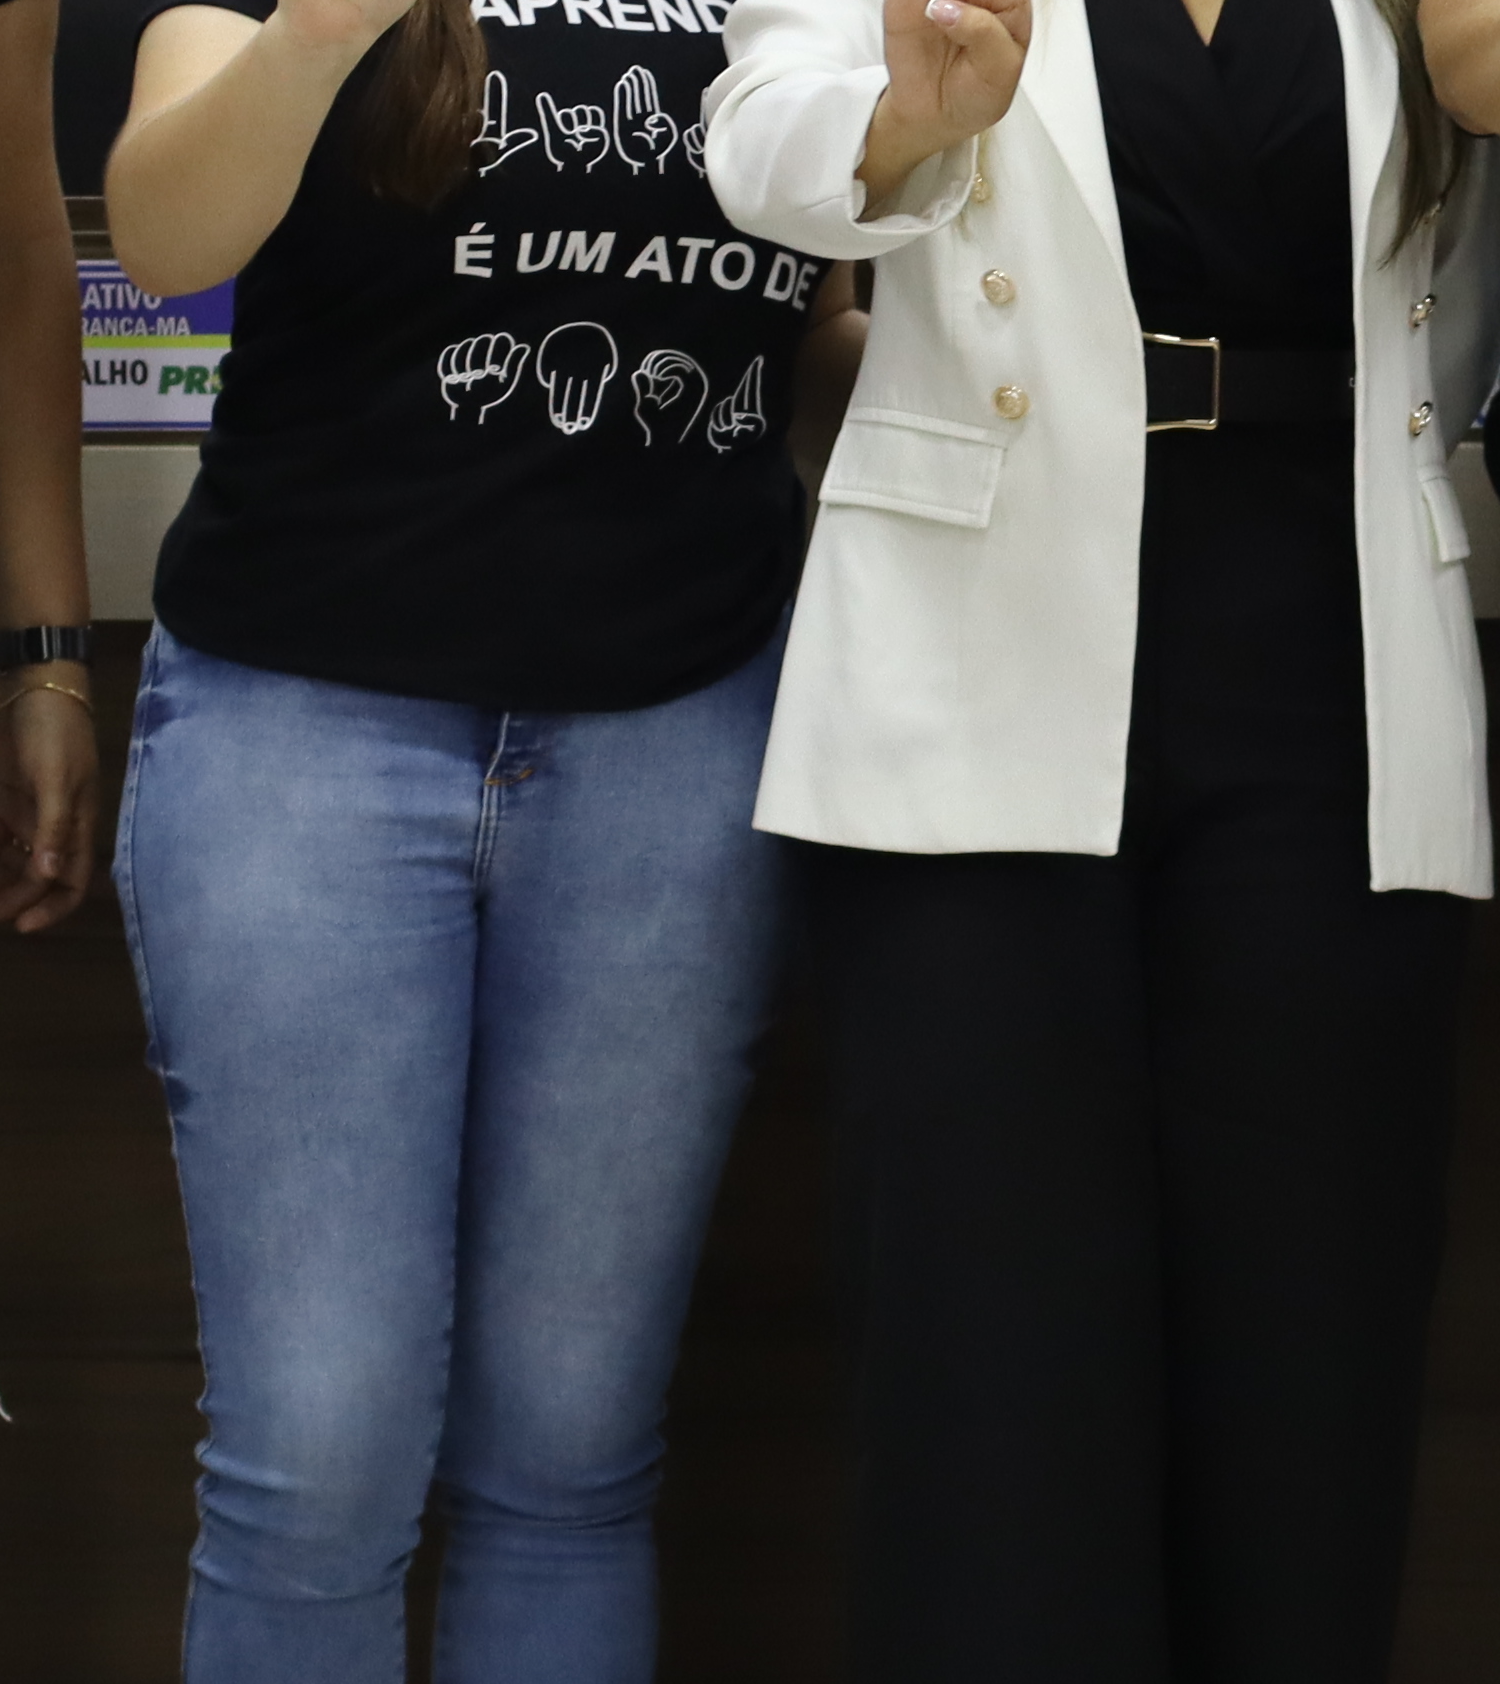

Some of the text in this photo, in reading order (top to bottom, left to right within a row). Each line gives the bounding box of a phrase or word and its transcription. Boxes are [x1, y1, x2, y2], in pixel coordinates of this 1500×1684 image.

[453, 222, 818, 312] É UM ATO DE
[80, 282, 163, 311] ATIVO
[81, 315, 192, 336] RANCA-MA
[81, 358, 149, 387] ALHO
